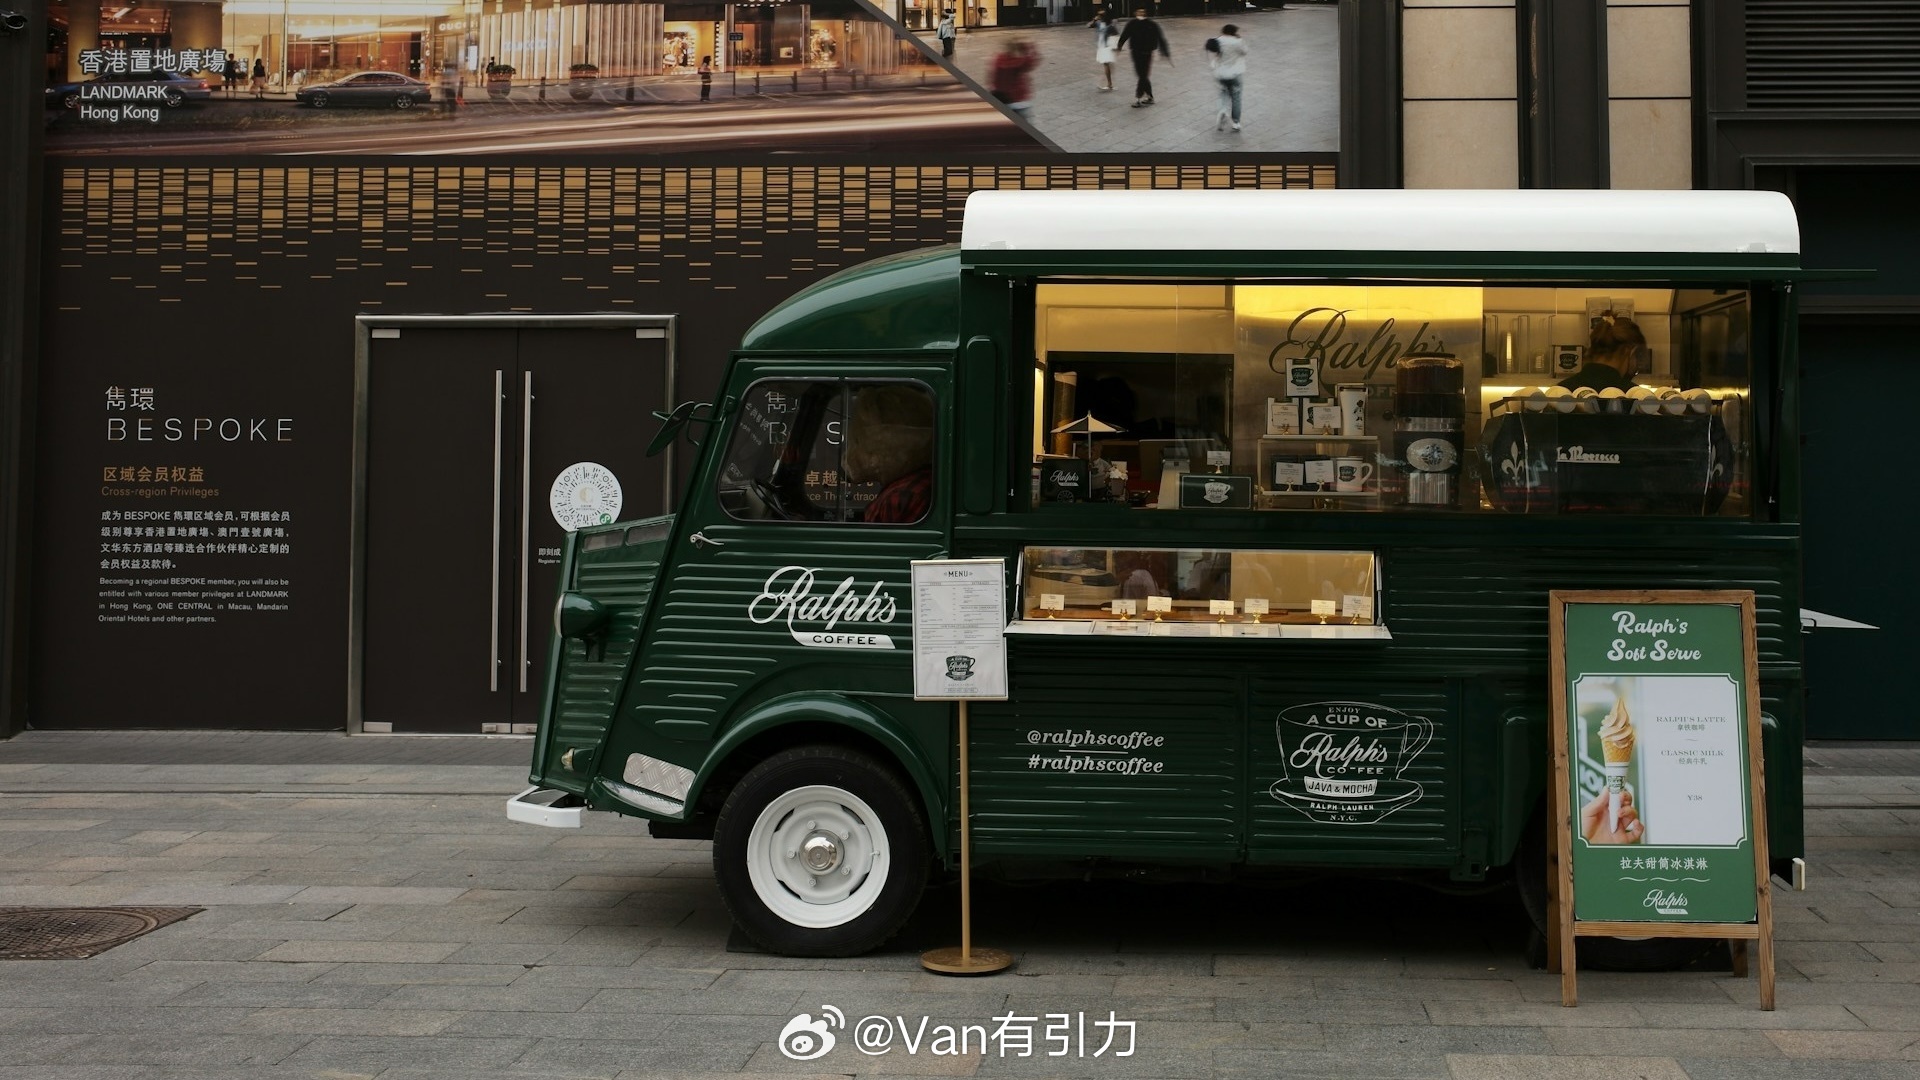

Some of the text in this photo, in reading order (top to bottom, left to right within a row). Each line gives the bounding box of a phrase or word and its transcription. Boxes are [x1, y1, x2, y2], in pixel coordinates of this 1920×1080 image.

[81, 86, 168, 99] LANDMARK
[80, 106, 160, 122] Hong Kong
[108, 418, 293, 441] BESPOKE
[104, 466, 205, 482] 区域会员权益
[102, 486, 219, 498] Cross-region Privileges
[102, 511, 121, 521] 成为
[124, 511, 170, 521] BESPOKE
[948, 570, 969, 578] MENU
[100, 578, 133, 587] Becoming
[141, 578, 169, 587] regional
[171, 578, 206, 586] BESPOKE
[238, 579, 250, 587] you
[252, 578, 263, 586] will
[265, 578, 278, 586] also
[280, 578, 289, 586] be
[99, 590, 289, 600] entitled with various member privileges at LANDMARK
[748, 566, 897, 632] Ralph's
[110, 602, 128, 612] Hong
[157, 602, 173, 610] ONE
[178, 602, 213, 610] CENTRAL
[98, 614, 125, 622] Oriental
[128, 614, 150, 622] Hotels
[167, 615, 184, 623] other
[1612, 610, 1688, 637] Ralph's
[812, 635, 876, 645] COFFEE
[1607, 638, 1702, 661] Soft Serve
[1328, 706, 1361, 714] ENJOY
[1306, 714, 1388, 729] A CUP OF
[1027, 729, 1164, 749] @ralphscoffee
[1289, 732, 1388, 778] Ralph's
[1028, 754, 1164, 775] #ralphscoffee
[1326, 766, 1385, 775] COFEE
[1308, 781, 1374, 794] JAVA & MOCHA
[1310, 802, 1375, 811] RALPH LAUREN
[1329, 814, 1358, 822] N.Y.C.
